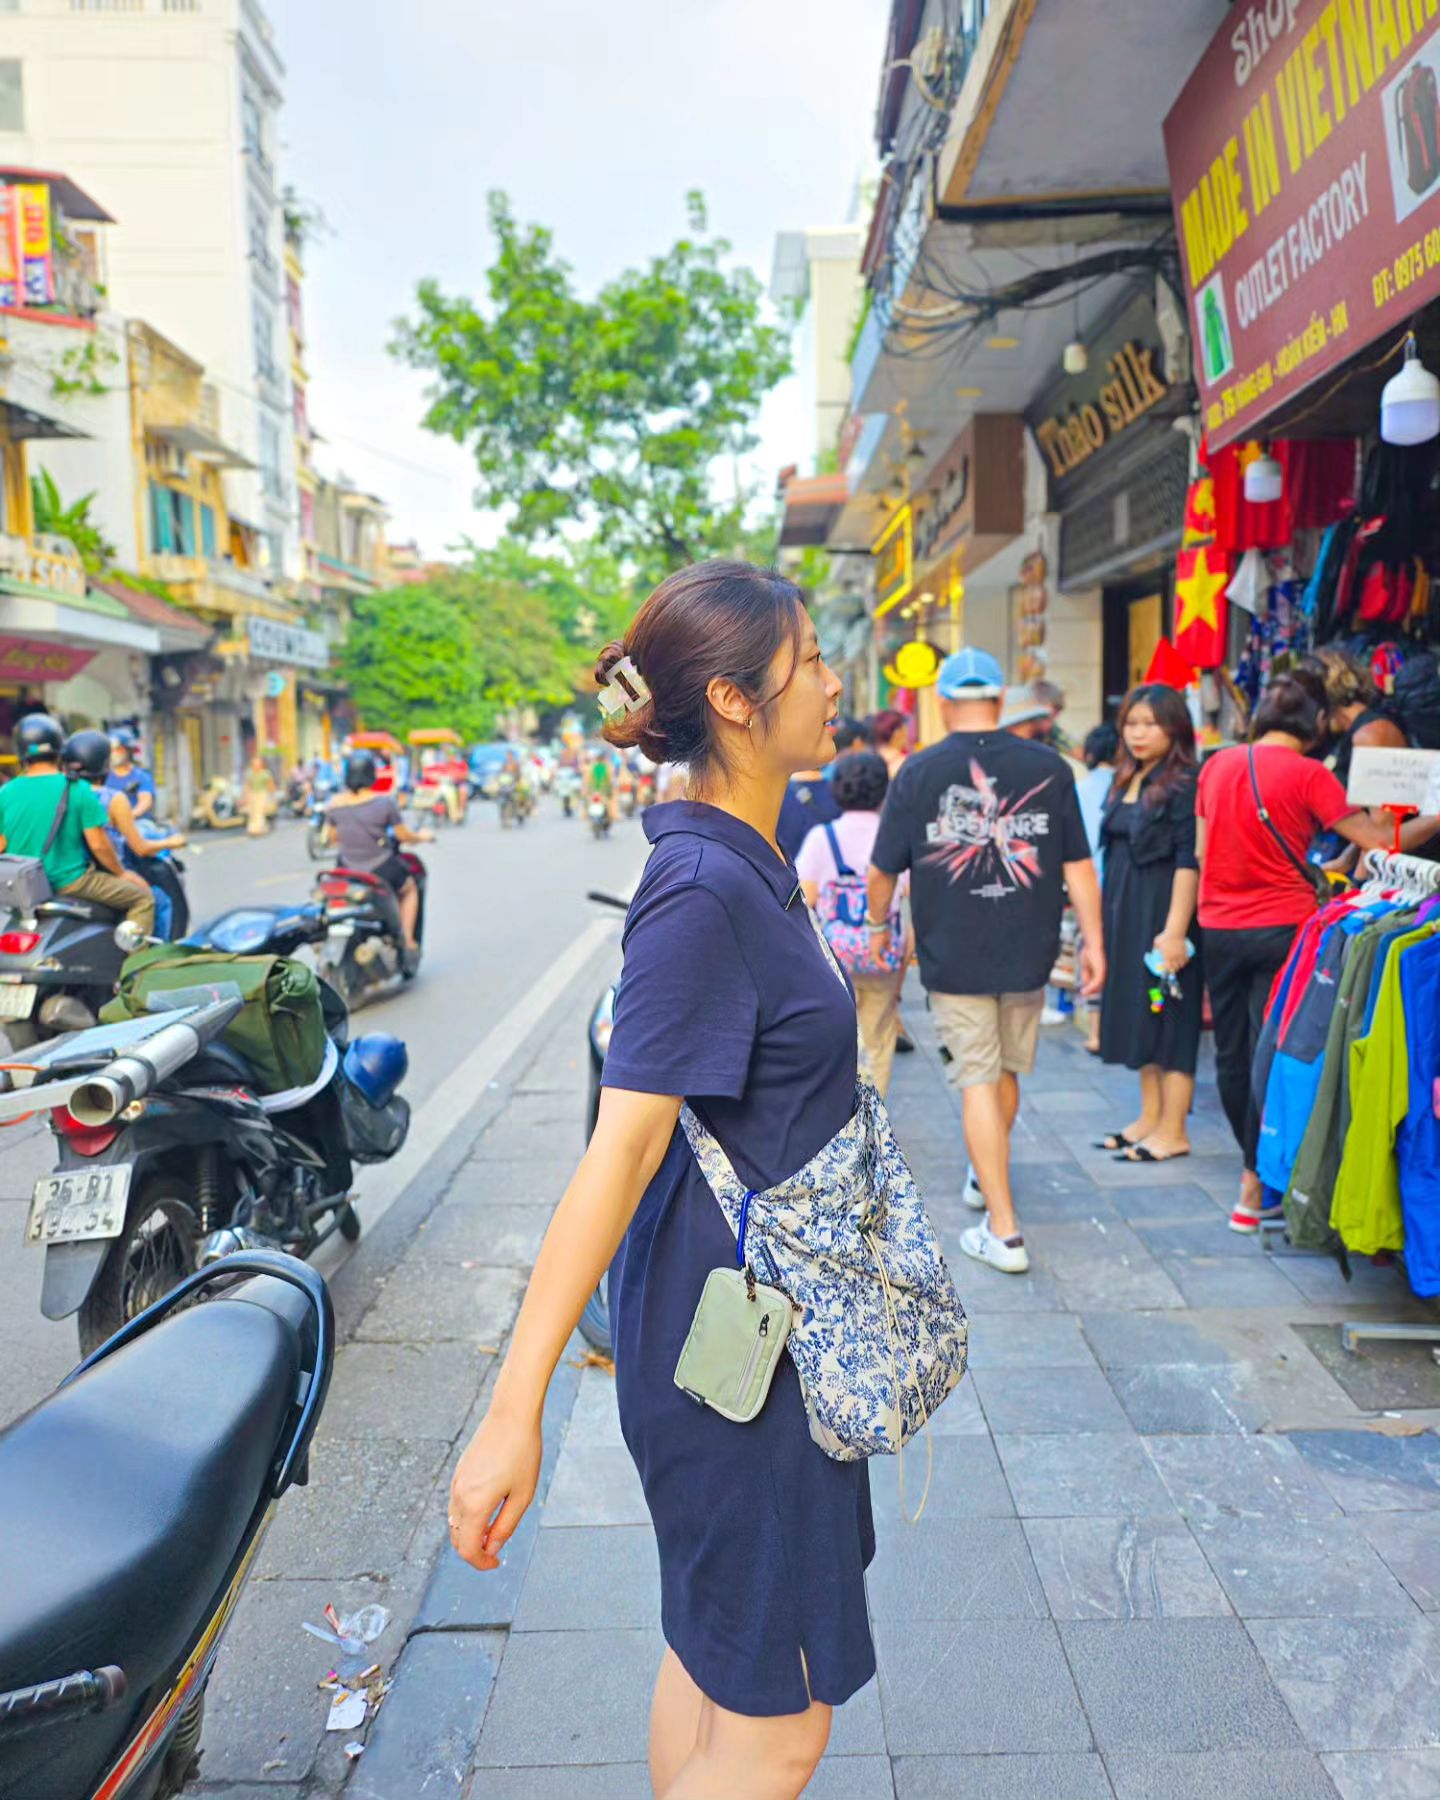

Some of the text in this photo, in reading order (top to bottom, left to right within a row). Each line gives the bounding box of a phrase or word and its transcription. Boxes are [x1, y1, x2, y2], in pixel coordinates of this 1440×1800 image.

[1181, 135, 1249, 289] MADE
[1242, 91, 1281, 217] IN
[1235, 152, 1368, 330] OUTLET FACTORY
[1099, 341, 1167, 432] silk
